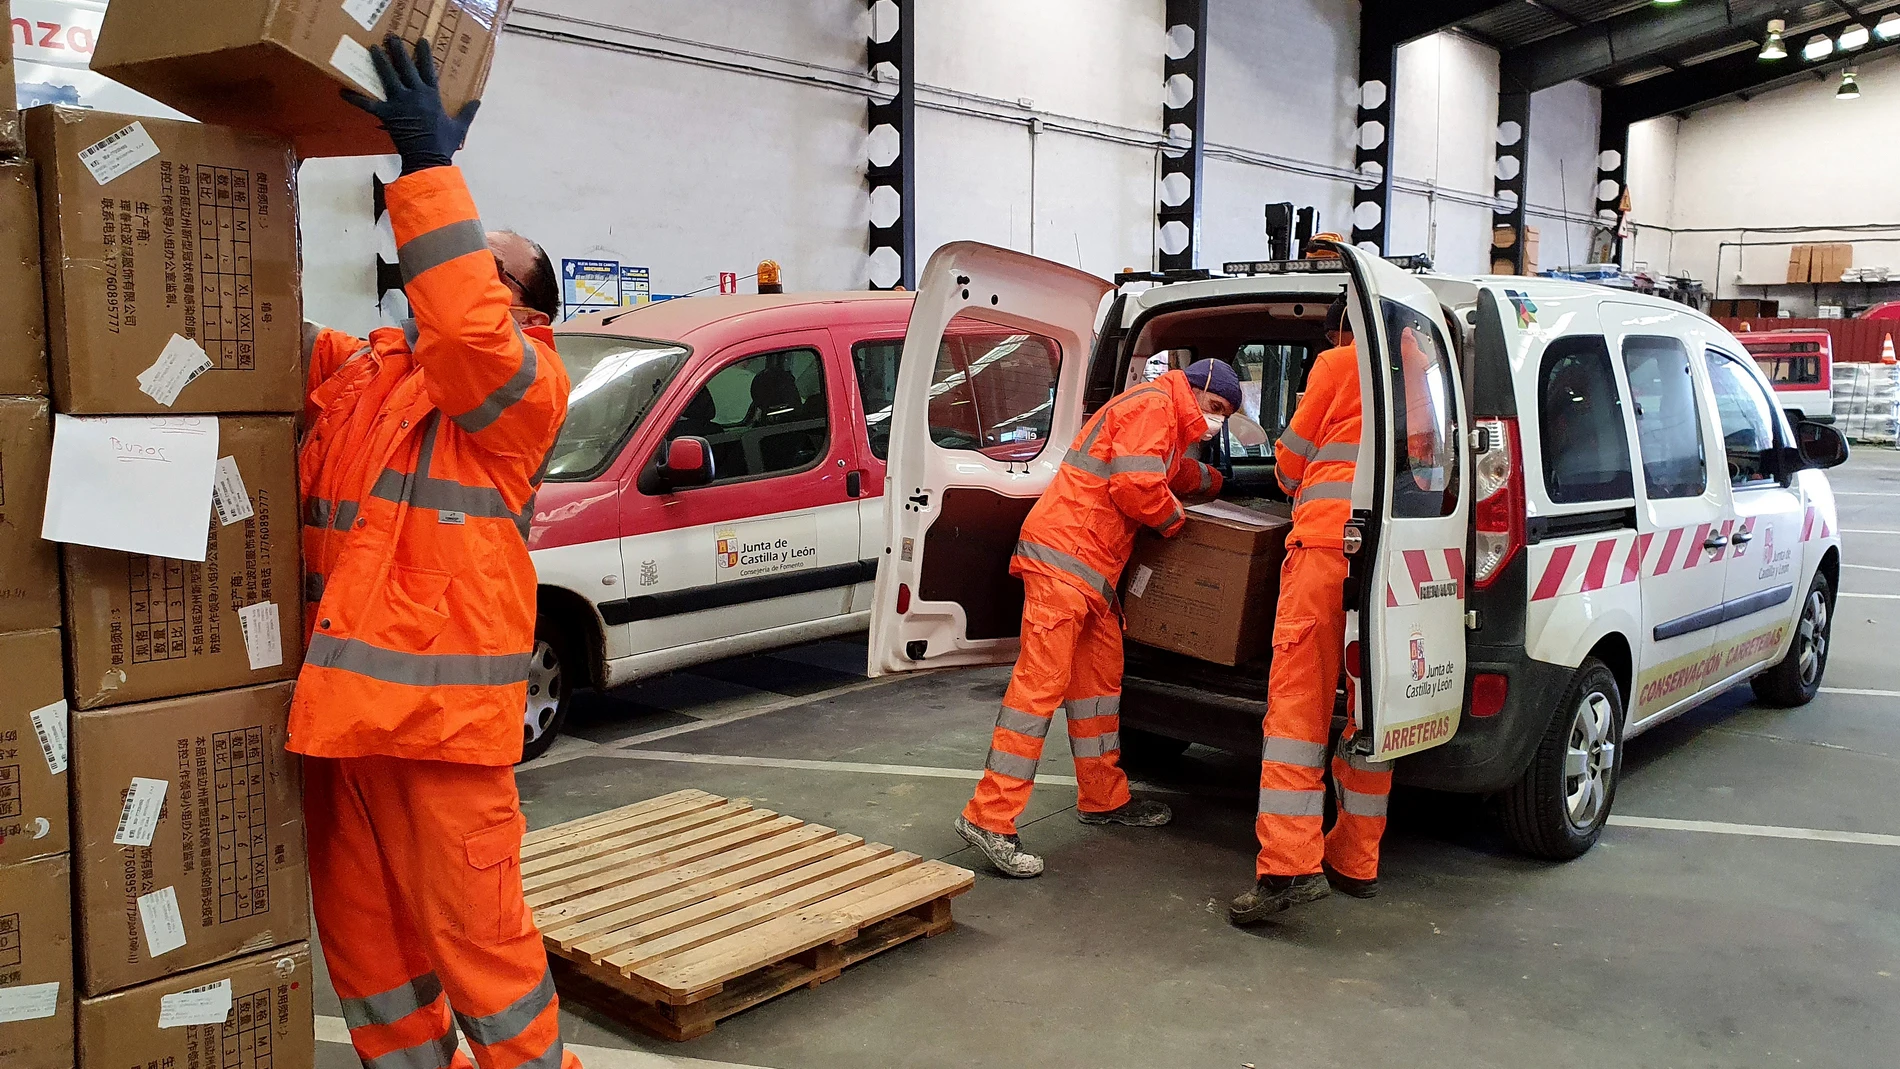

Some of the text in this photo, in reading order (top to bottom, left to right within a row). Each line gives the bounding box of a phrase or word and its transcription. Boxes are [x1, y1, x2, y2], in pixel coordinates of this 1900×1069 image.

[236, 220, 246, 231] M
[239, 284, 250, 297] XL
[240, 313, 251, 335] XXL
[741, 539, 788, 553] Junta de
[740, 546, 816, 565] Castilla y León
[740, 566, 770, 576] Consejería
[780, 561, 804, 570] Fomento
[135, 602, 147, 612] M
[1426, 660, 1454, 679] Junta de
[1638, 626, 1783, 706] CONSERVACIÓN CARRETERAS
[1405, 677, 1453, 699] Castilla y León
[1381, 715, 1450, 754] ARRETERAS
[251, 775, 261, 785] M
[237, 811, 246, 820] 12
[253, 834, 263, 848] XL
[254, 862, 265, 881] XXL
[258, 1036, 267, 1046] M
